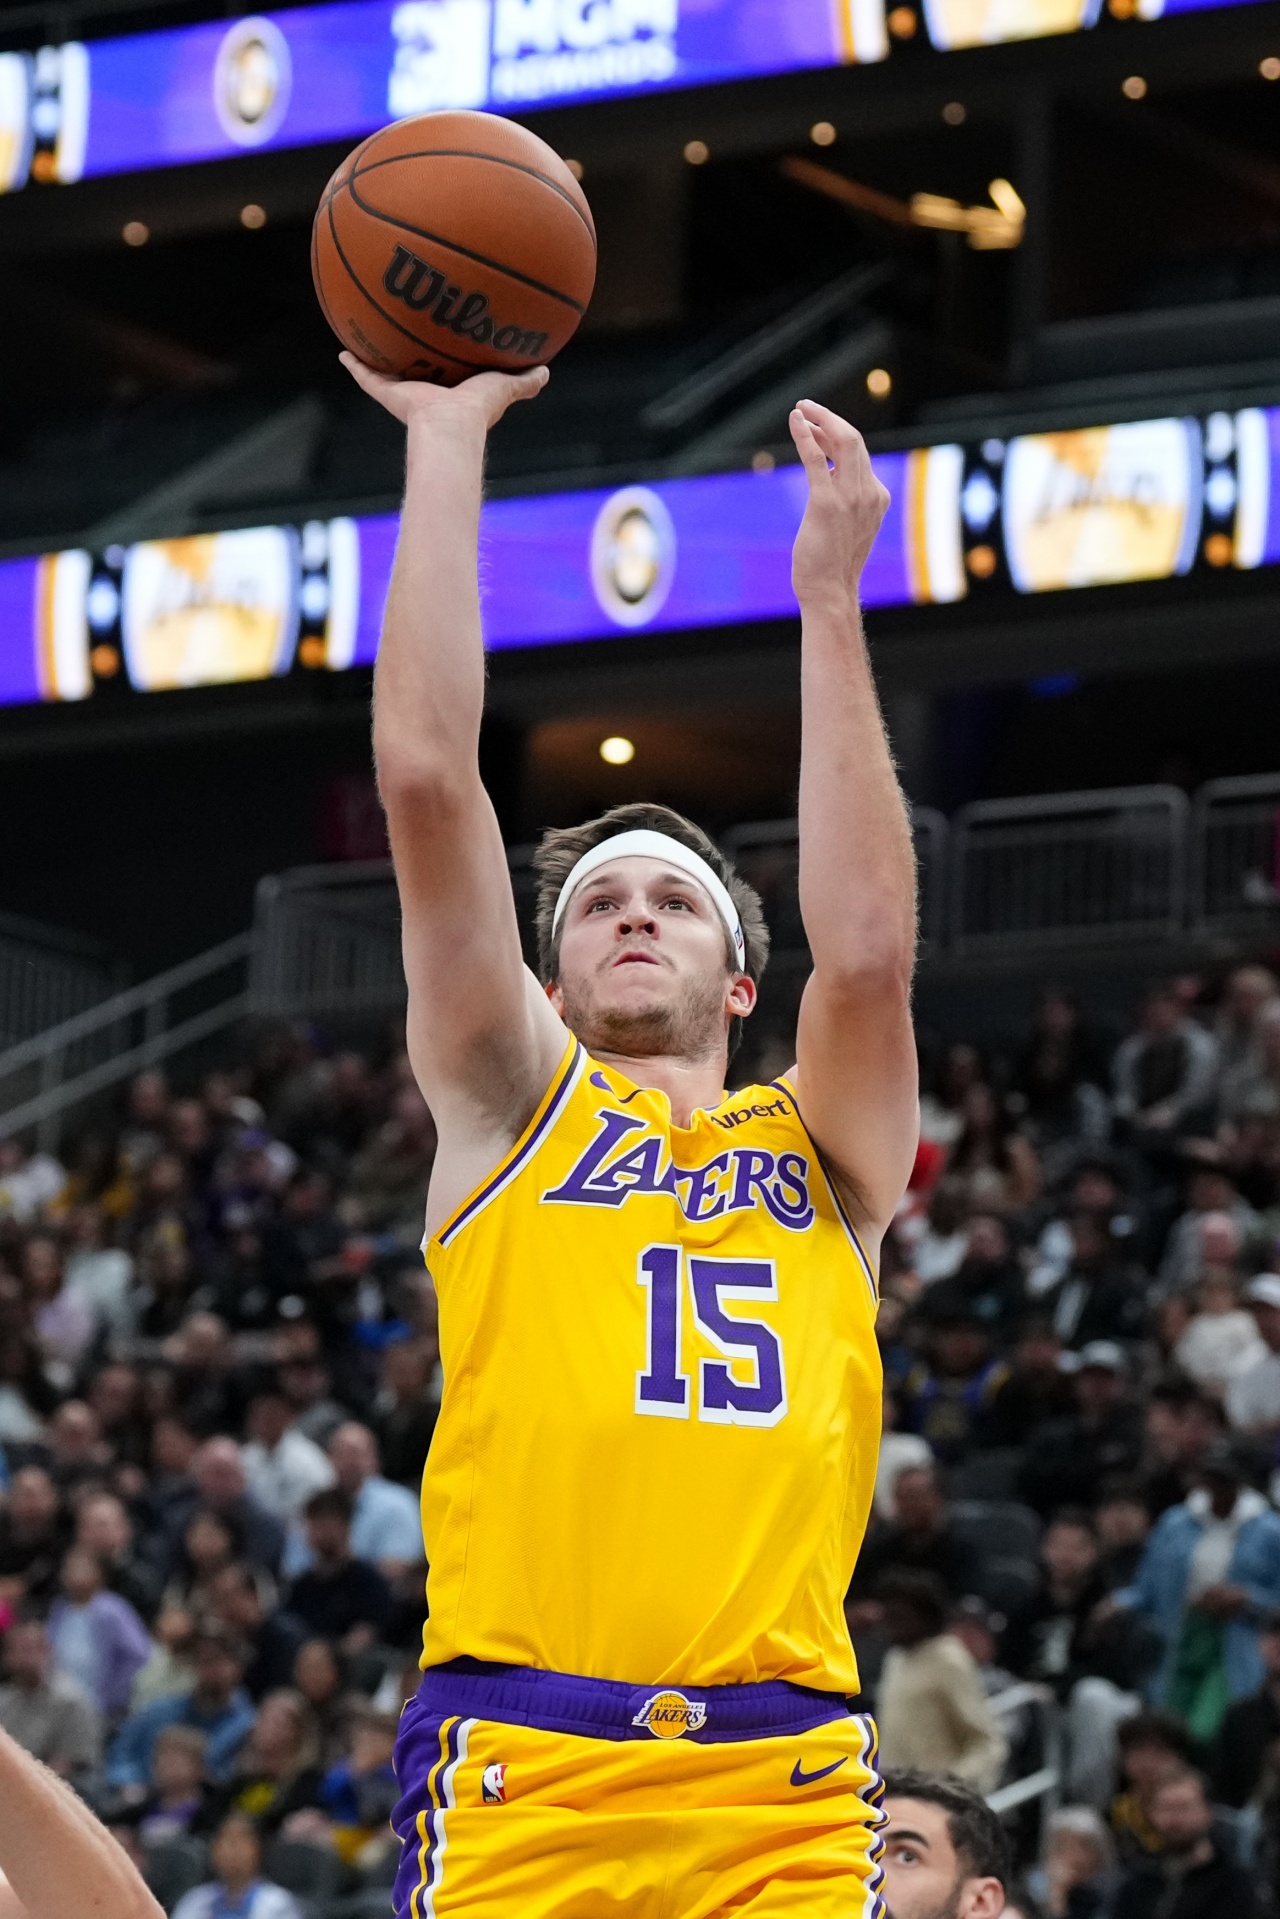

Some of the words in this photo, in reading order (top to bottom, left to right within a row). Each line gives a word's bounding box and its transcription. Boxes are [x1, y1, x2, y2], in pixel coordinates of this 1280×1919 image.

[383, 244, 548, 357] Wilson
[539, 1106, 815, 1233] LAERS
[634, 1242, 788, 1428] 15
[632, 1702, 705, 1729] LAKERS
